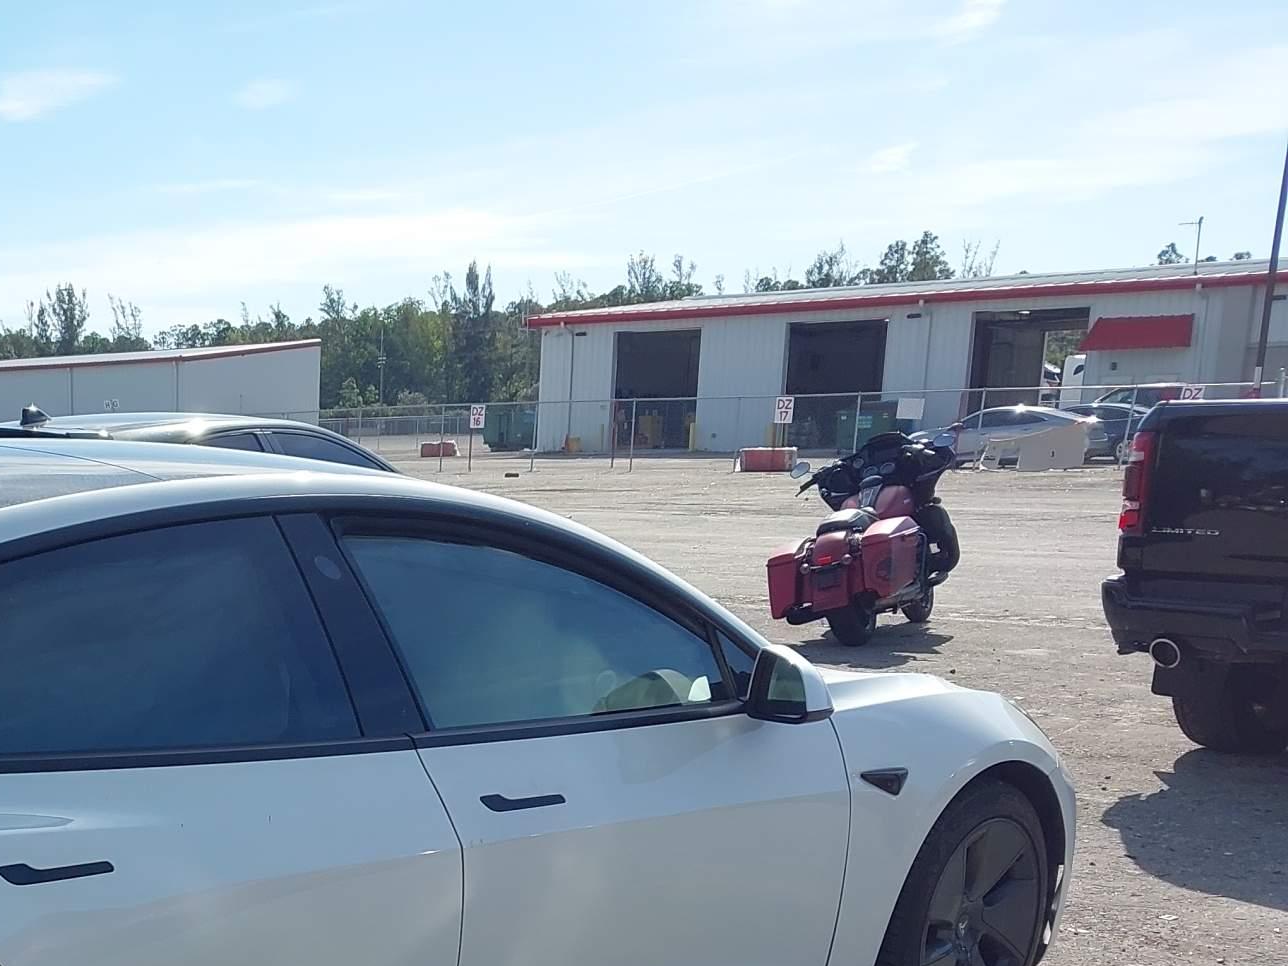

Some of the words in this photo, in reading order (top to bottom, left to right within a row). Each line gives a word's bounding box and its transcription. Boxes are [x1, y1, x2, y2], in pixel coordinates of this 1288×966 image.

[1183, 388, 1203, 400] DZ
[777, 399, 793, 410] DZ
[472, 406, 484, 416] DZ
[779, 411, 789, 421] 17
[473, 417, 481, 426] 16
[1151, 527, 1220, 536] LIMITED
